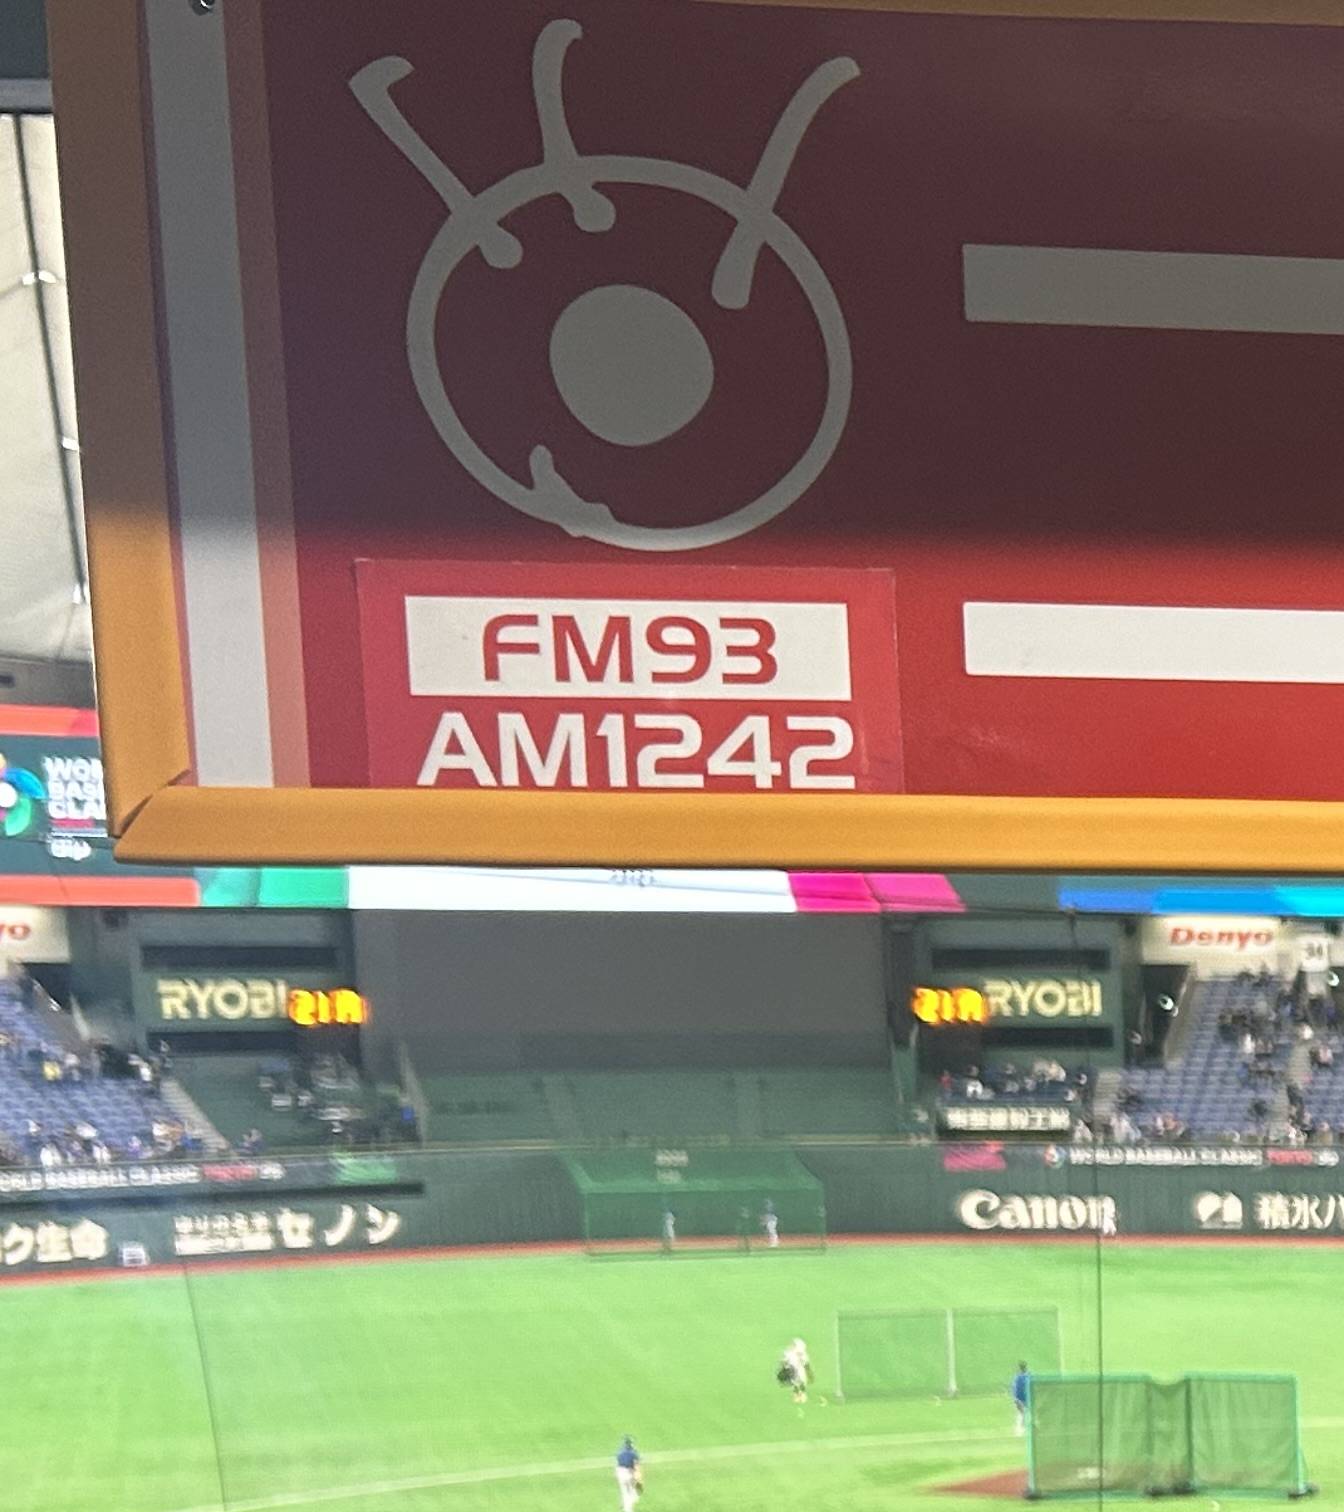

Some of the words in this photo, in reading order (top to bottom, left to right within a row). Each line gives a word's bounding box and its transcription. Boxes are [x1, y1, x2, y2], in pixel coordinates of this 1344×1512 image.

[483, 614, 778, 685] FM93
[417, 711, 856, 789] AM1242
[1170, 927, 1273, 951] Denyo
[157, 978, 288, 1020] RYOBI
[984, 979, 1102, 1018] RYOBI
[959, 1189, 1113, 1231] Canon
[0, 1219, 110, 1265] ク生命
